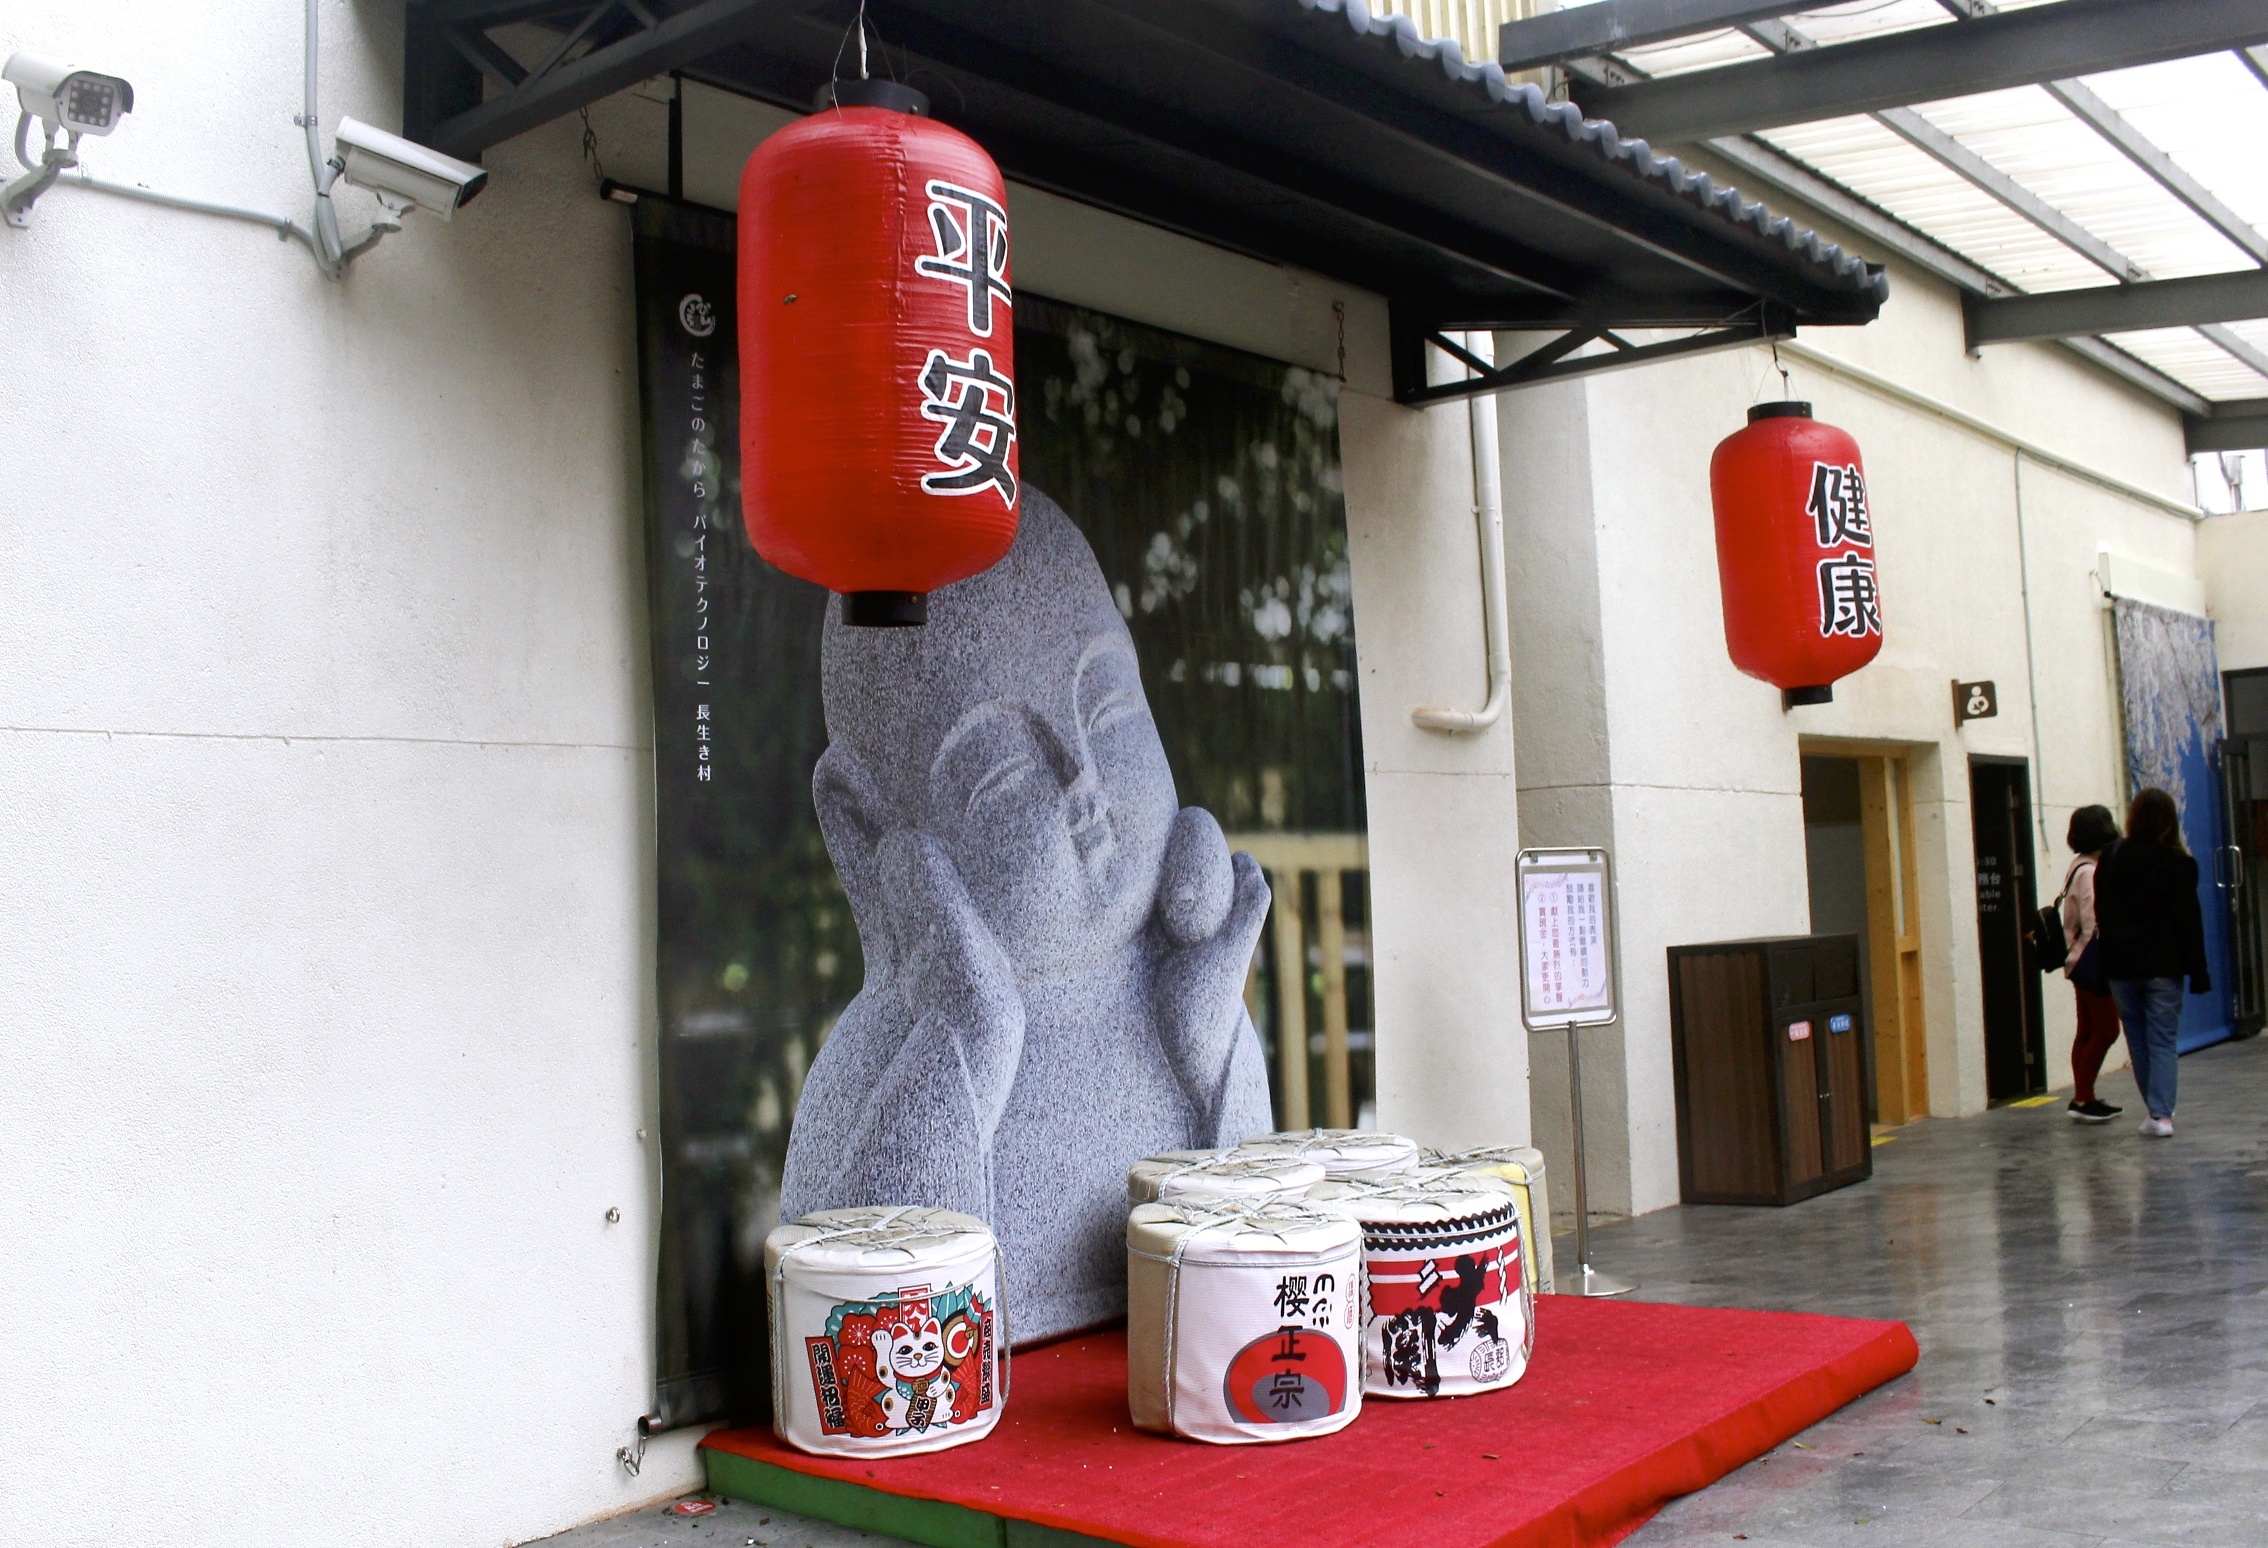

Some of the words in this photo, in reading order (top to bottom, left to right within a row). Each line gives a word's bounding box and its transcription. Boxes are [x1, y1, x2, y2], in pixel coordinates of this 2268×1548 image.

[914, 179, 1018, 511] 平安
[1804, 461, 1883, 639] 健康
[696, 703, 711, 782] 長生き村
